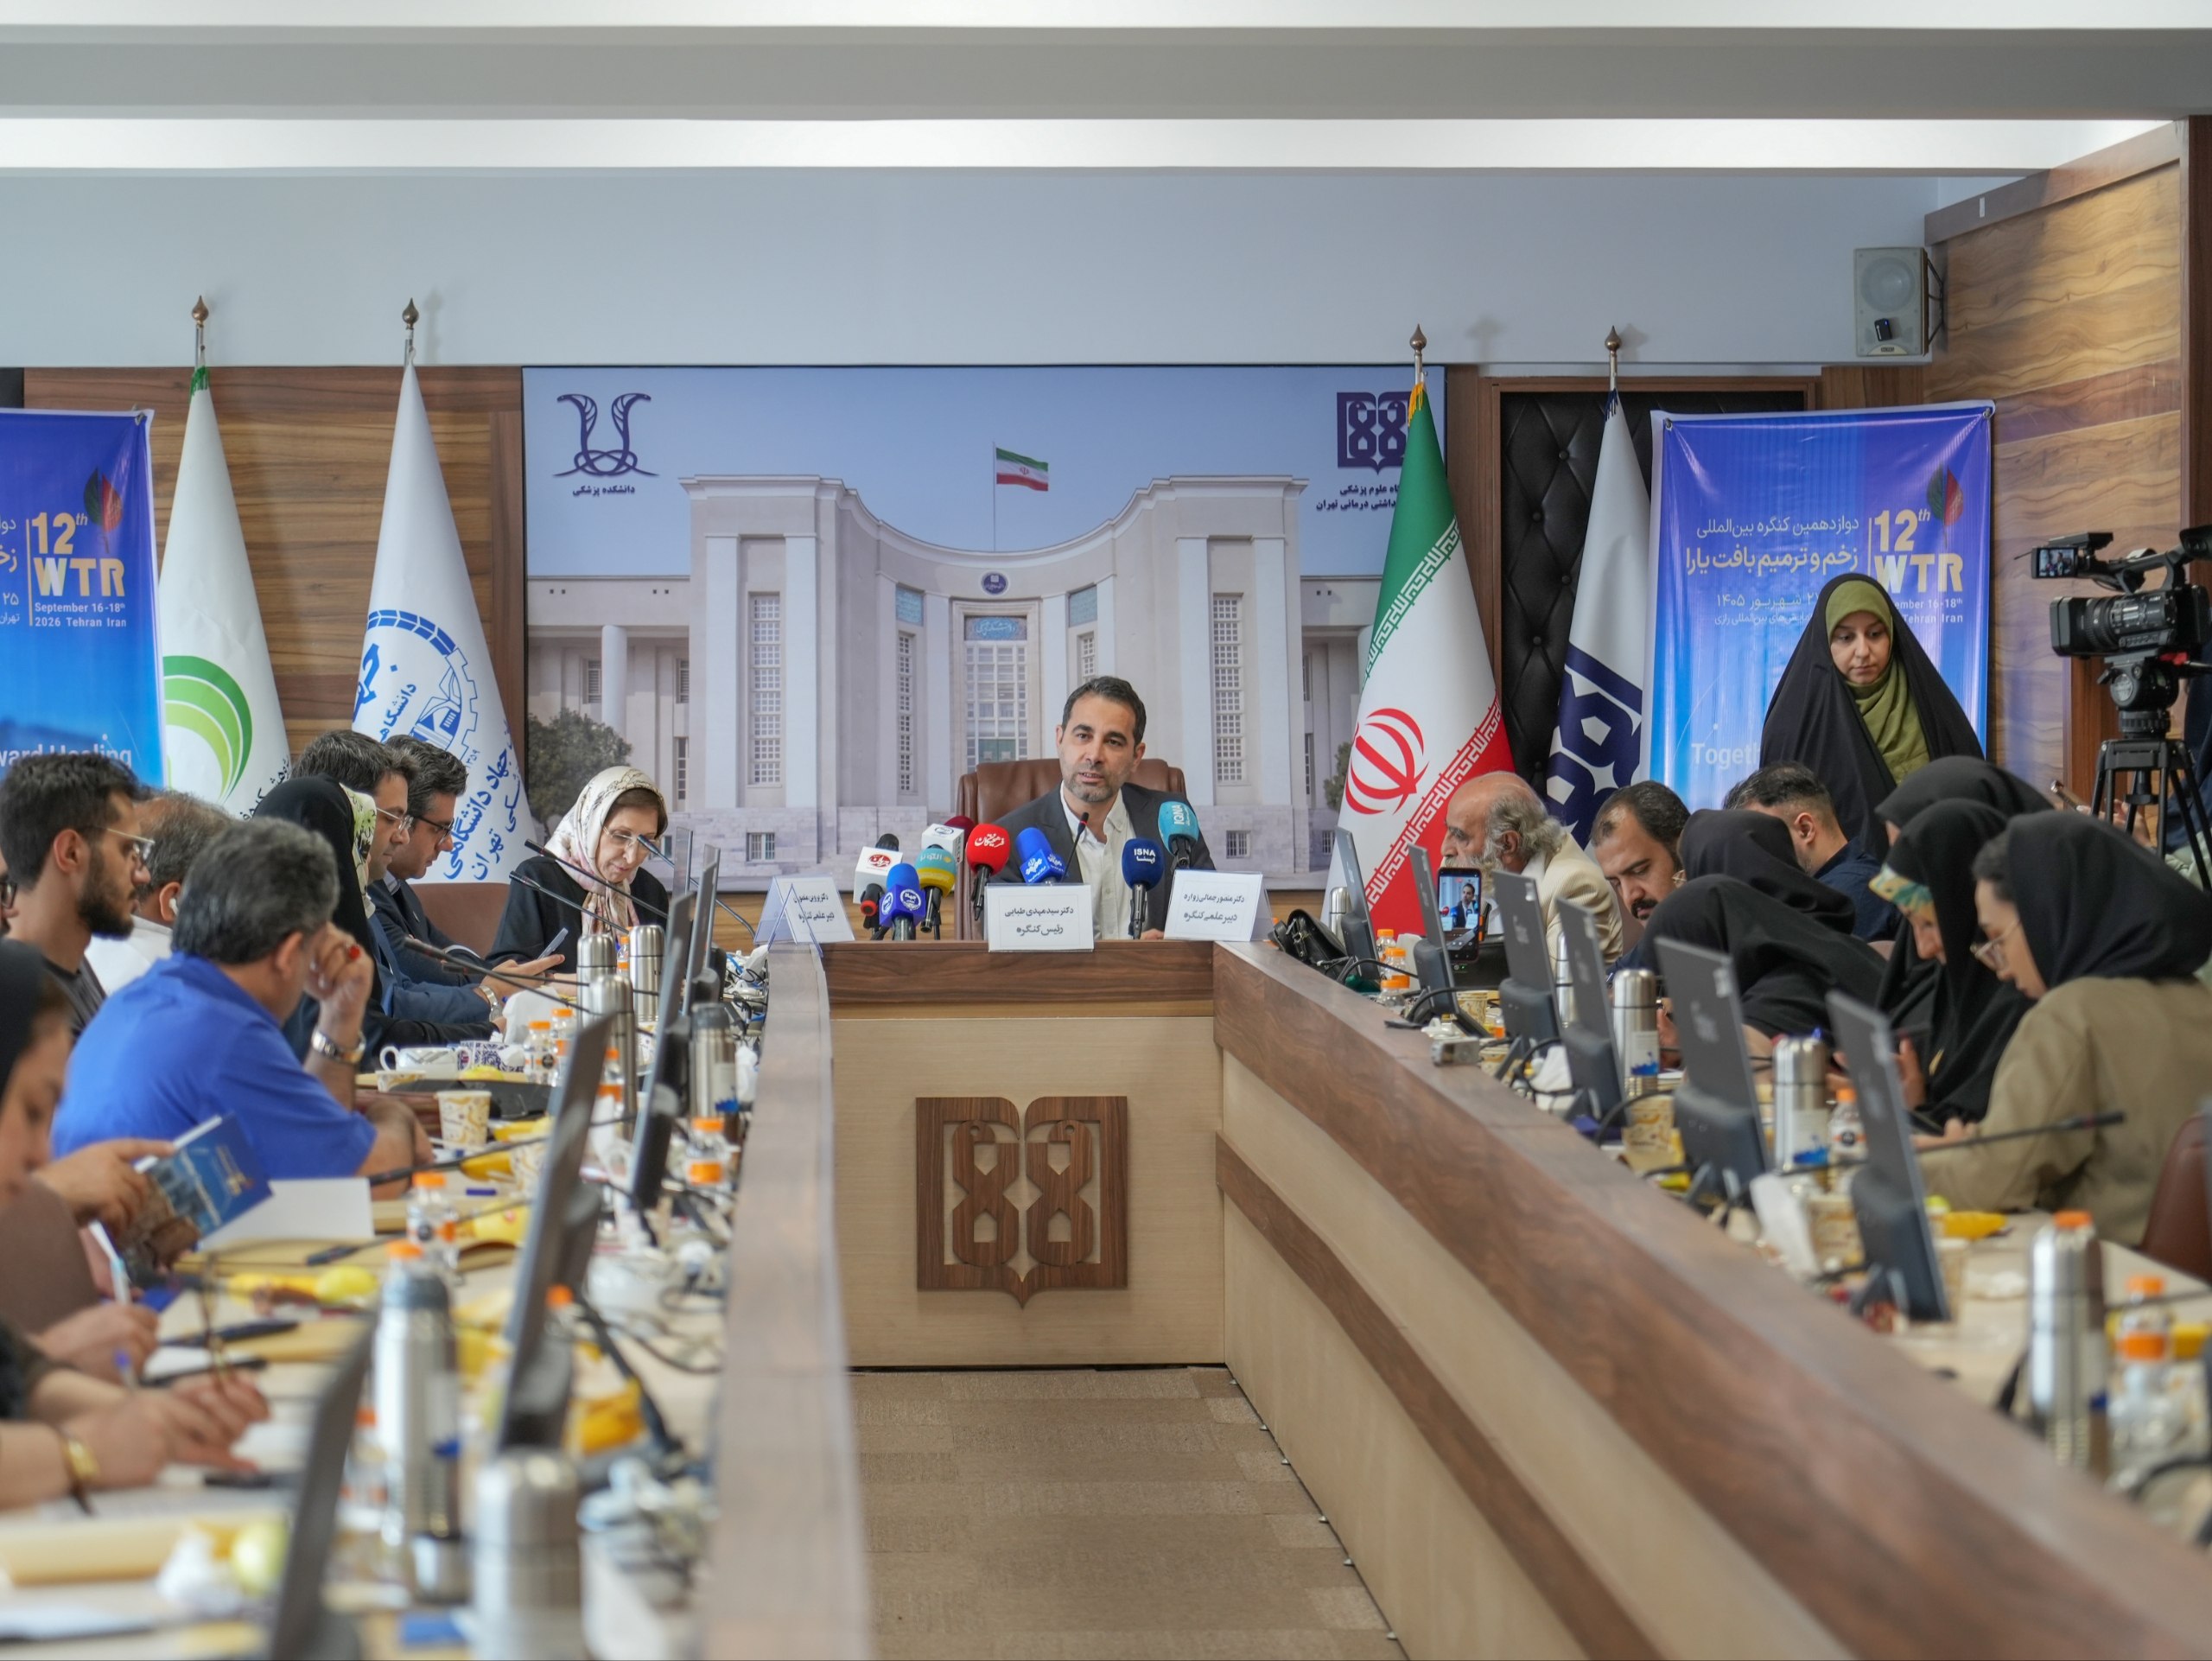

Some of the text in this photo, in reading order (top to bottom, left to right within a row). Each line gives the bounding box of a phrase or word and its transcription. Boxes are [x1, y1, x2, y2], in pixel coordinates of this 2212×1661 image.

[573, 485, 635, 497] دانشکده پزشکی
[1340, 484, 1367, 496] پزشکی
[1370, 484, 1387, 496] علوم
[1316, 499, 1396, 511] داشتی درمانی تهران
[1757, 516, 1790, 537] کنگره
[1792, 515, 1859, 536] دوازدهمین
[1686, 544, 1859, 577] زخم و ترمیم بافت یارا
[33, 557, 125, 597] WTR
[1874, 552, 1964, 595] WTR
[35, 602, 88, 614] September
[1749, 594, 1802, 611] شهریور
[1894, 599, 1924, 609] ember
[35, 617, 127, 627] 2026 Tehran Iran
[1902, 614, 1963, 624] Tehran Iran
[1134, 848, 1156, 856] ISNA
[1026, 907, 1046, 916] مهدی
[1060, 907, 1074, 916] دکتر
[1184, 910, 1237, 924] دبیر علمی کنگره
[1016, 924, 1064, 936] رئیس کنگره
